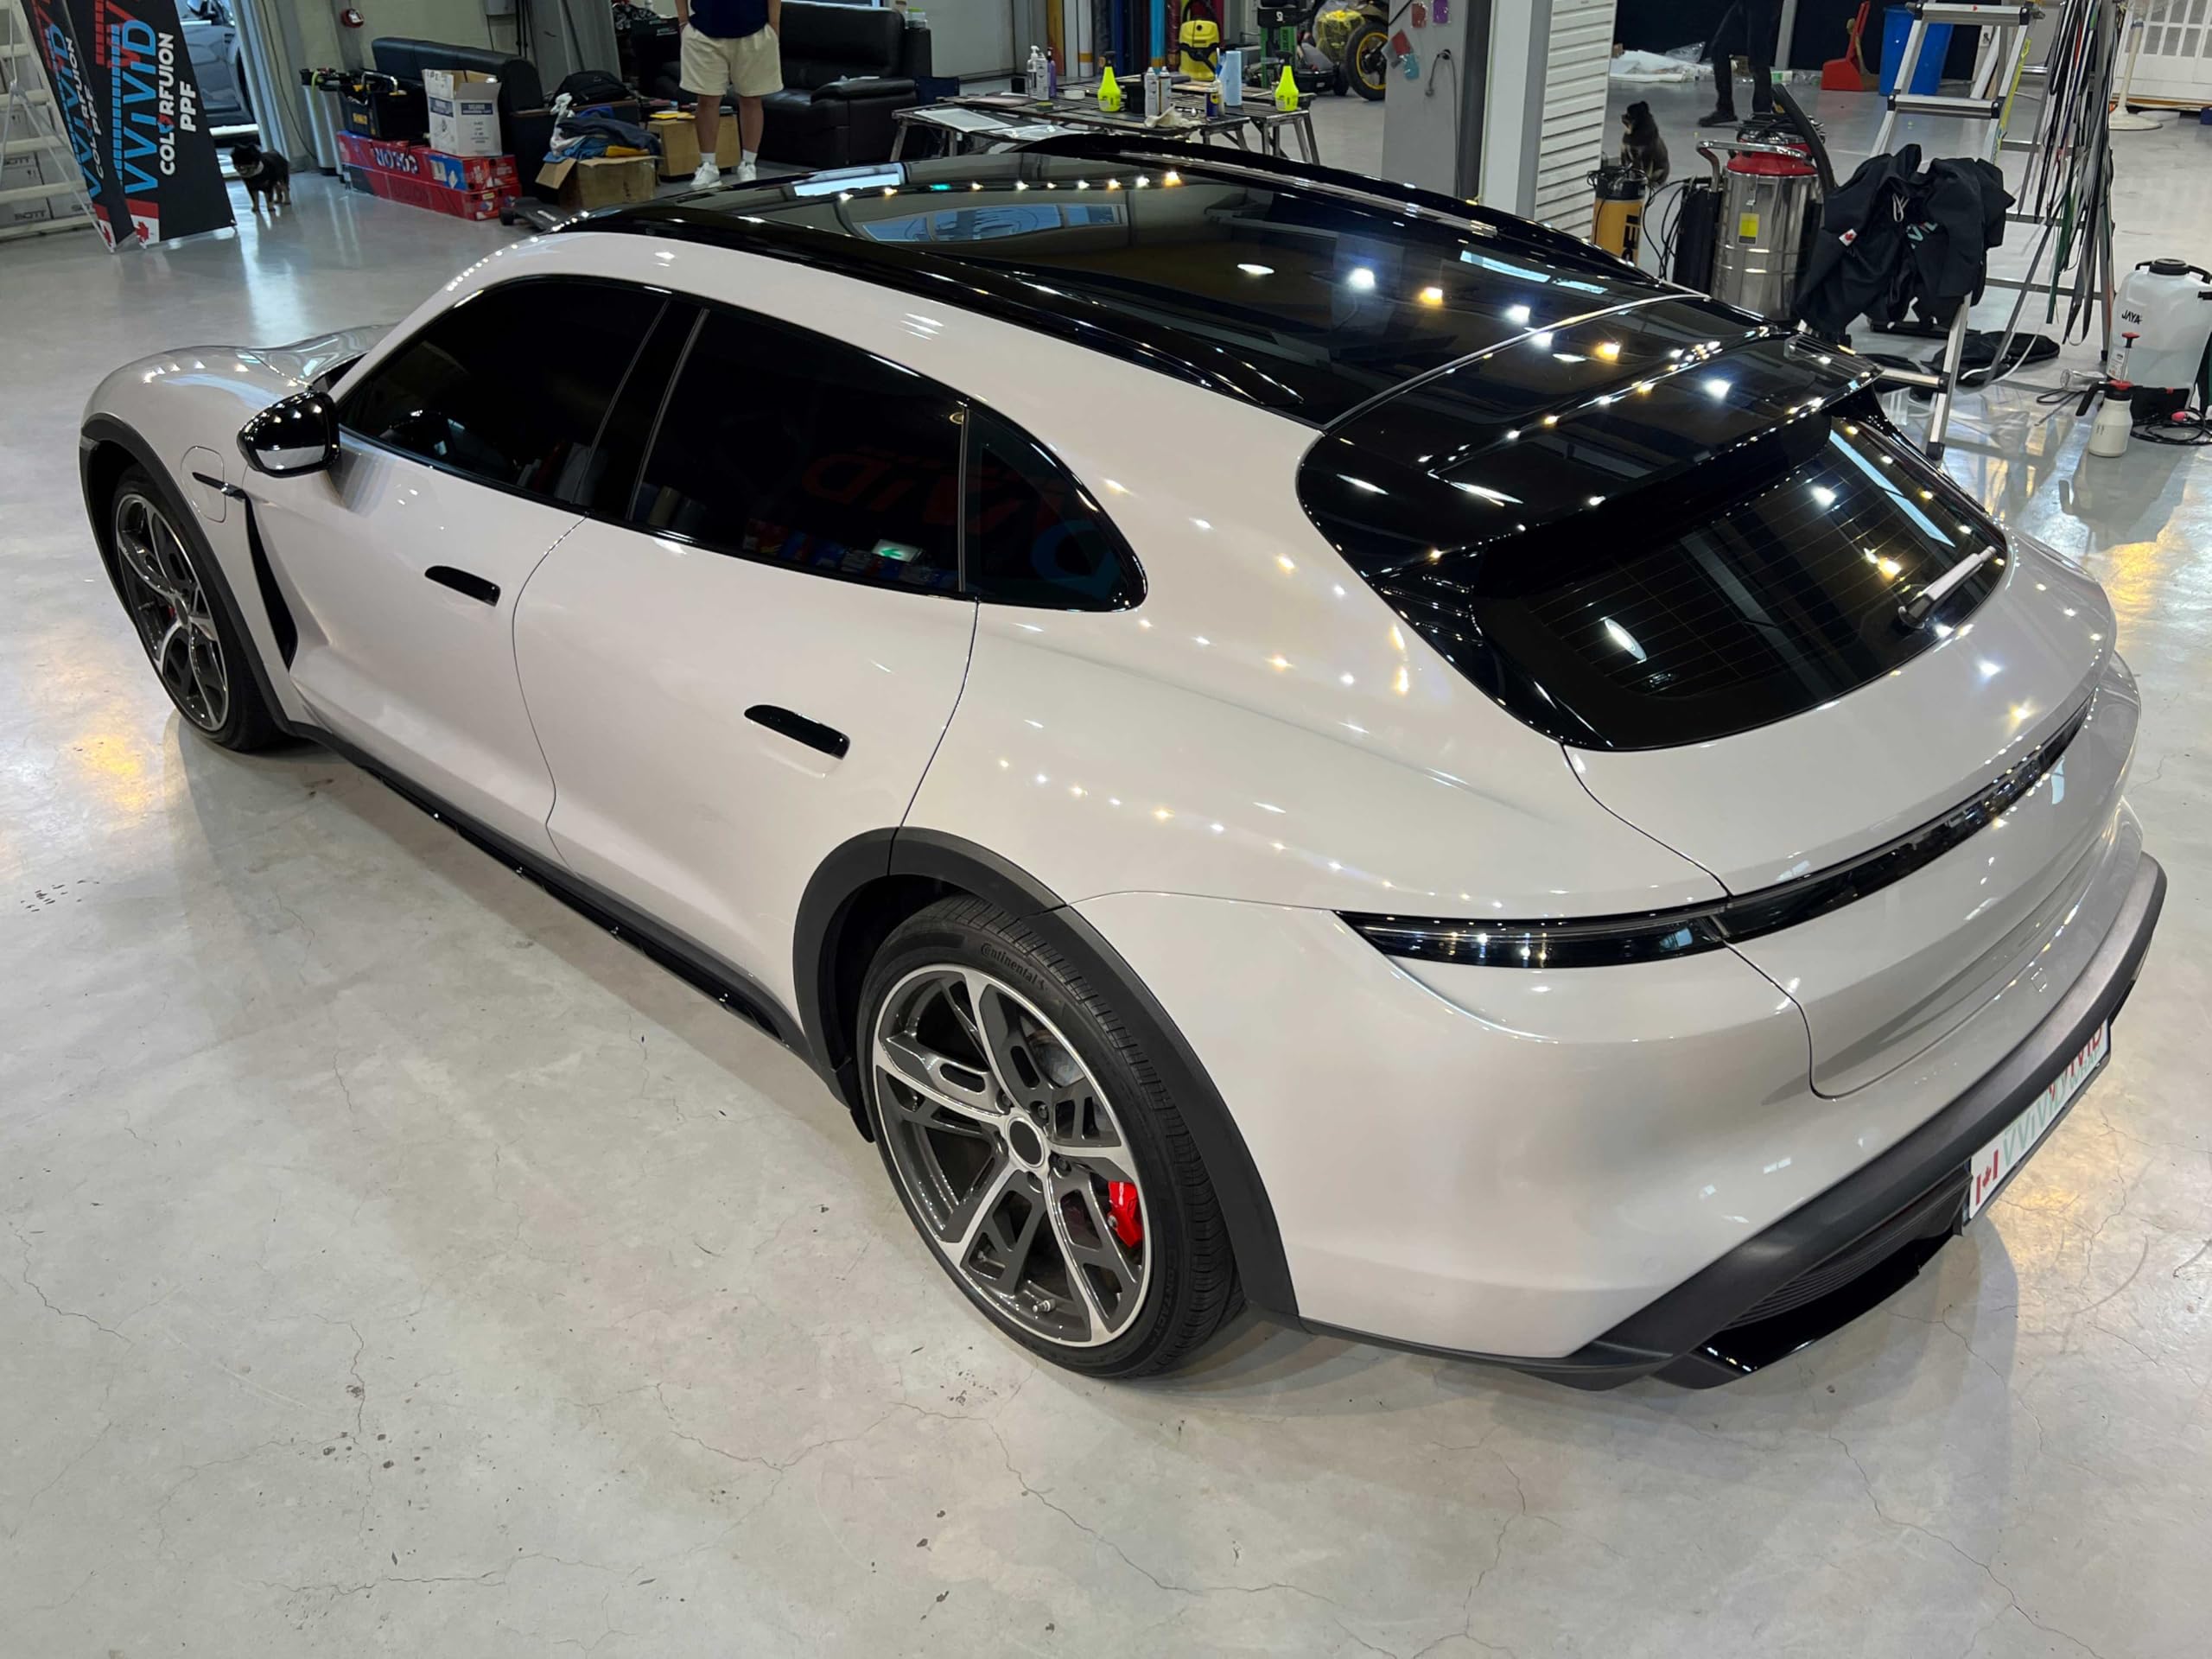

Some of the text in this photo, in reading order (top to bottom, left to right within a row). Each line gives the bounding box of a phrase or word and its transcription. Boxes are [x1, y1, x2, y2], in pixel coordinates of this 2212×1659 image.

[84, 85, 102, 136] PPF
[180, 81, 198, 132] PPF
[980, 942, 1038, 984] Continental
